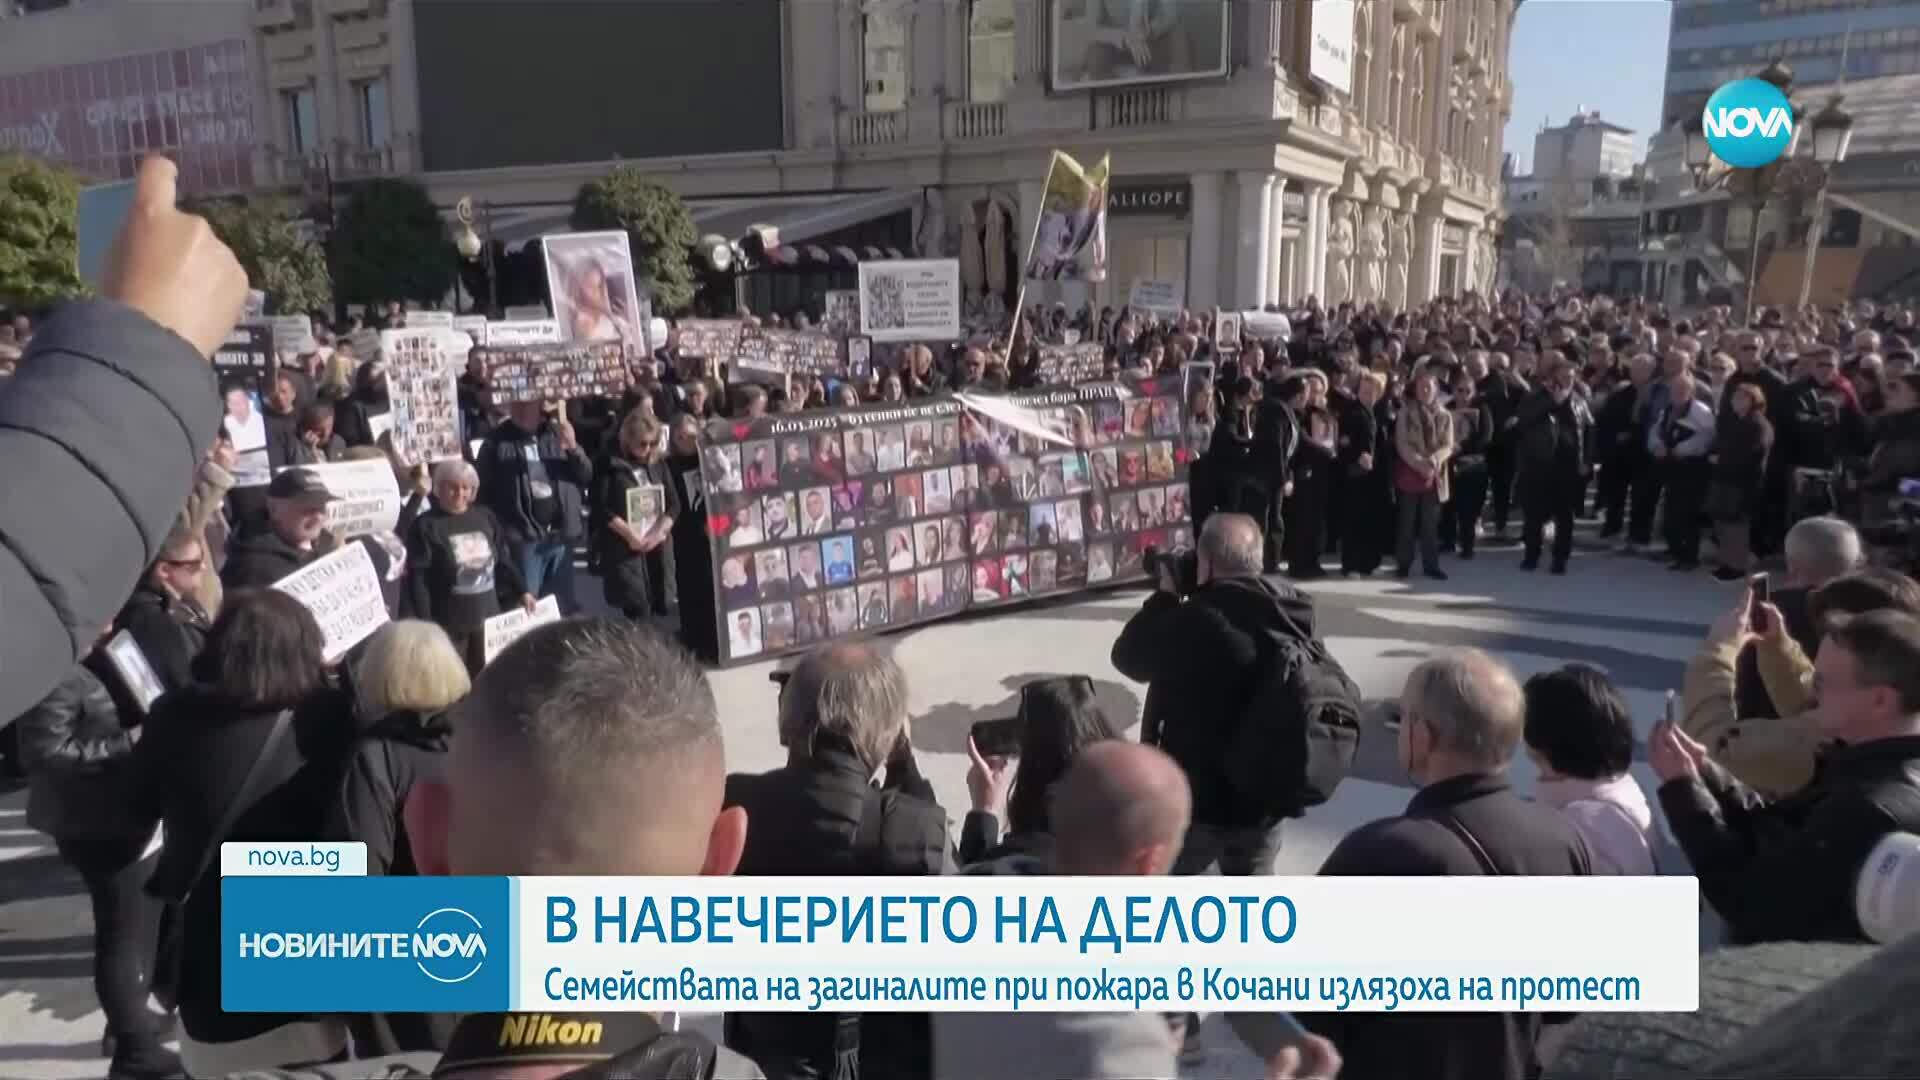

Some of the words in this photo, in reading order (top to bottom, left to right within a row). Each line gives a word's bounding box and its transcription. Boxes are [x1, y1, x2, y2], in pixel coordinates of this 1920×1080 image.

[1109, 191, 1184, 207] ALLIOPE
[771, 415, 837, 434] 16.03.2025
[499, 1015, 602, 1045] Nikon
